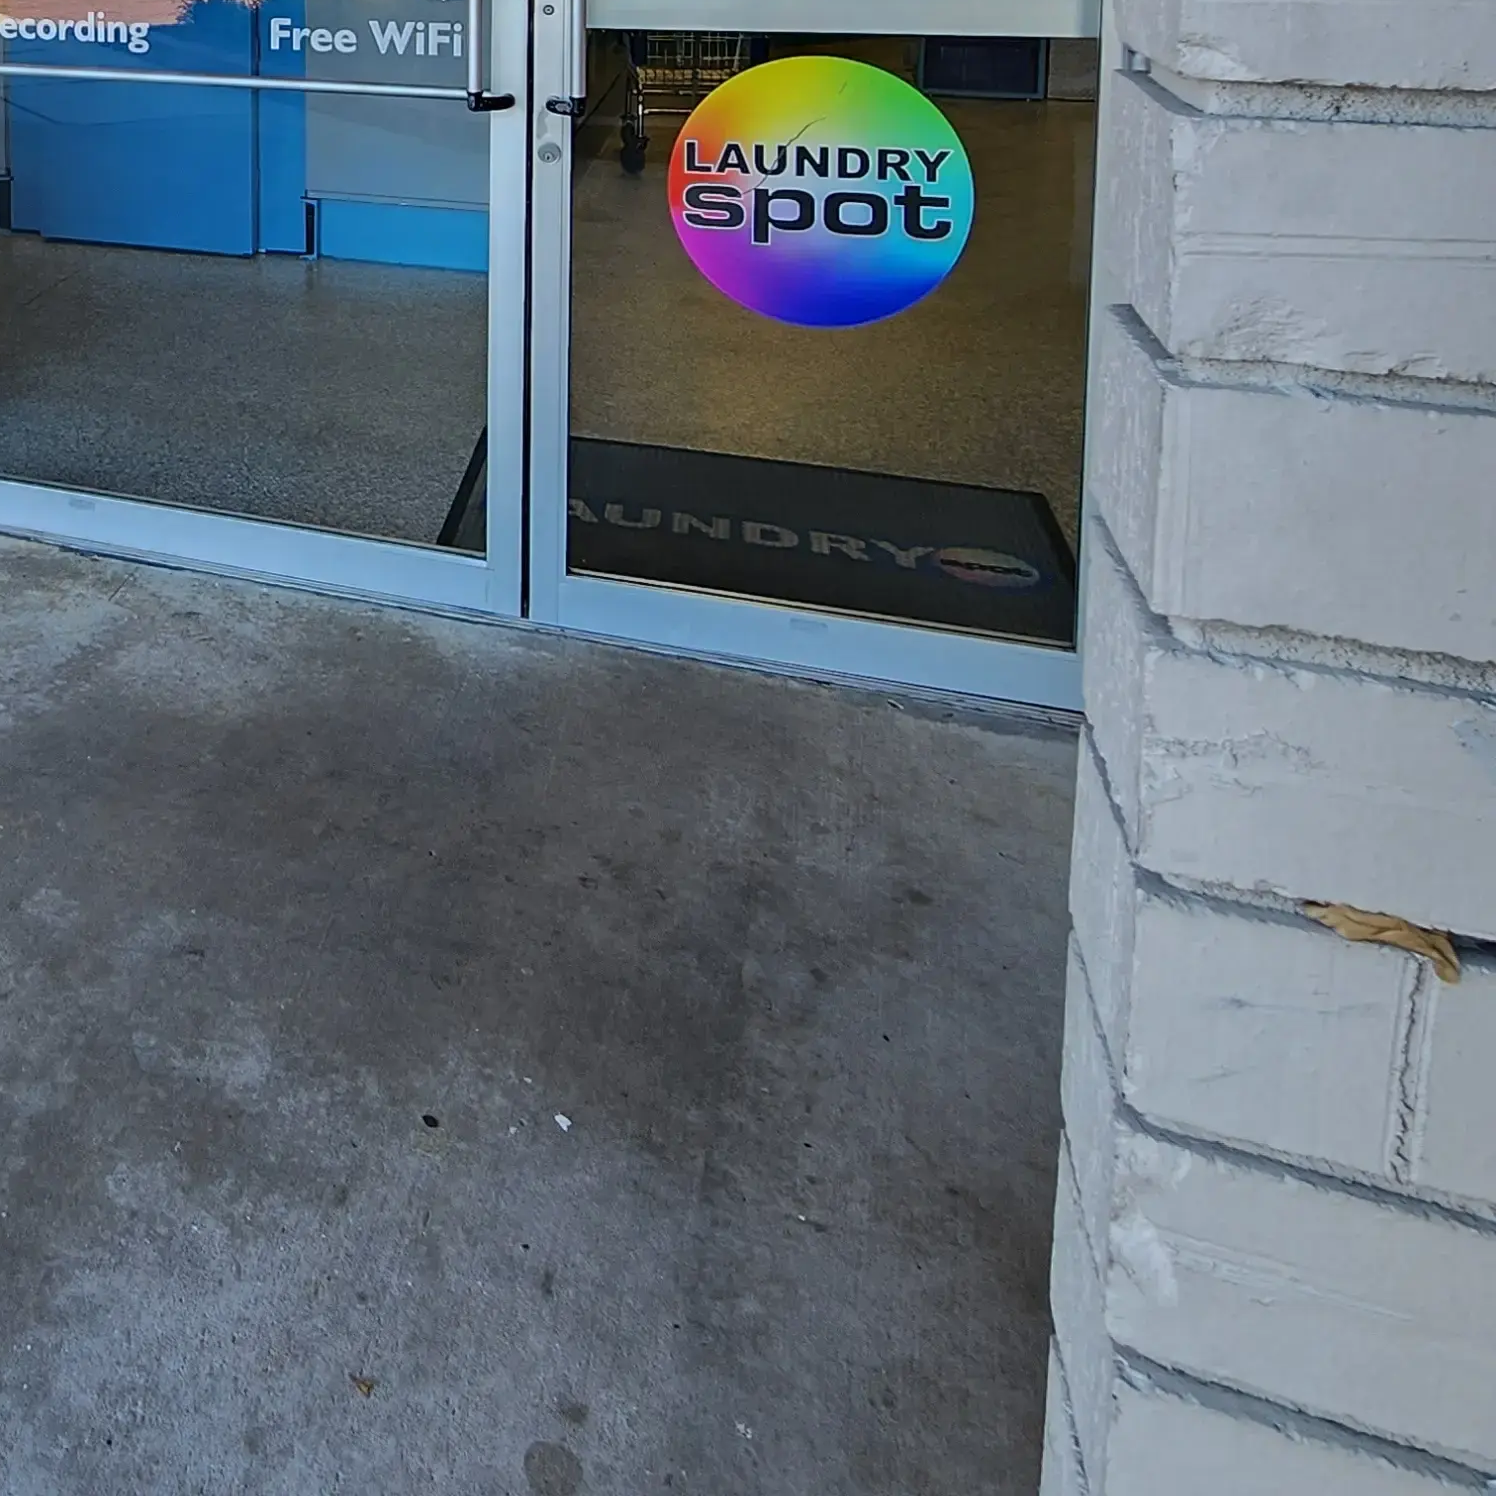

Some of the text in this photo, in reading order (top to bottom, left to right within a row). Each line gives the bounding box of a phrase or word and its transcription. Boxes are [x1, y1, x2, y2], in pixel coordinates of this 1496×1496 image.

[269, 17, 464, 56] Free WiFi
[684, 140, 954, 182] LAUNDRY
[568, 497, 933, 569] AUNDRY
